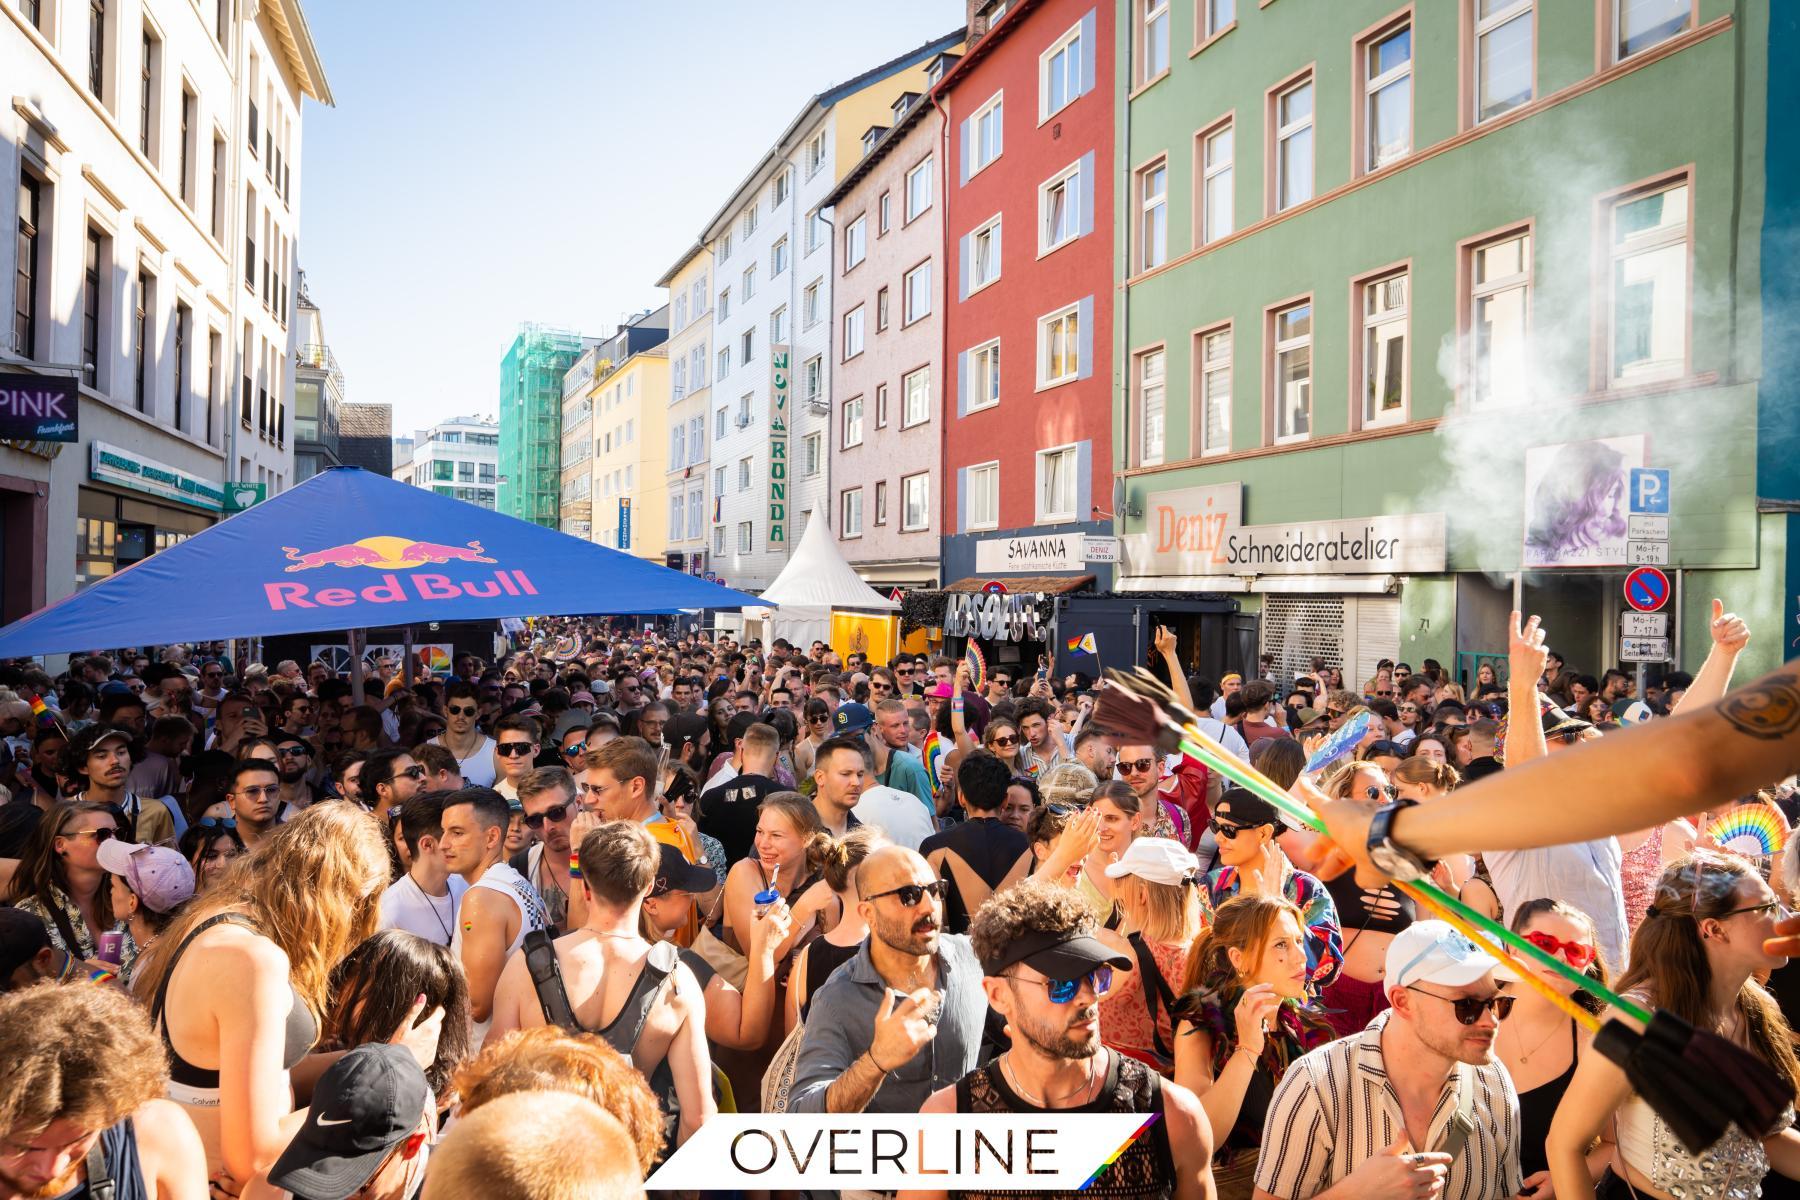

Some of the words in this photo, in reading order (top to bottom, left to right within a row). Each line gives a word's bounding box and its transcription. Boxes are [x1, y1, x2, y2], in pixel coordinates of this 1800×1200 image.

[771, 351, 788, 431] NOVA
[0, 389, 67, 419] PINK
[770, 441, 786, 542] RONDA
[1639, 473, 1661, 508] P
[1156, 496, 1228, 564] Deniz
[1008, 538, 1066, 559] SAVANNA
[1090, 546, 1109, 554] DENIZ
[1227, 526, 1400, 564] Schneideratelier
[1596, 547, 1627, 557] STYL
[1636, 544, 1660, 553] Mo-Fr
[263, 574, 408, 611] Red
[410, 570, 539, 600] Bull
[1420, 618, 1430, 629] 71
[1632, 616, 1659, 624] Mo-Fr
[104, 943, 116, 953] 12
[192, 1096, 216, 1105] Calvin
